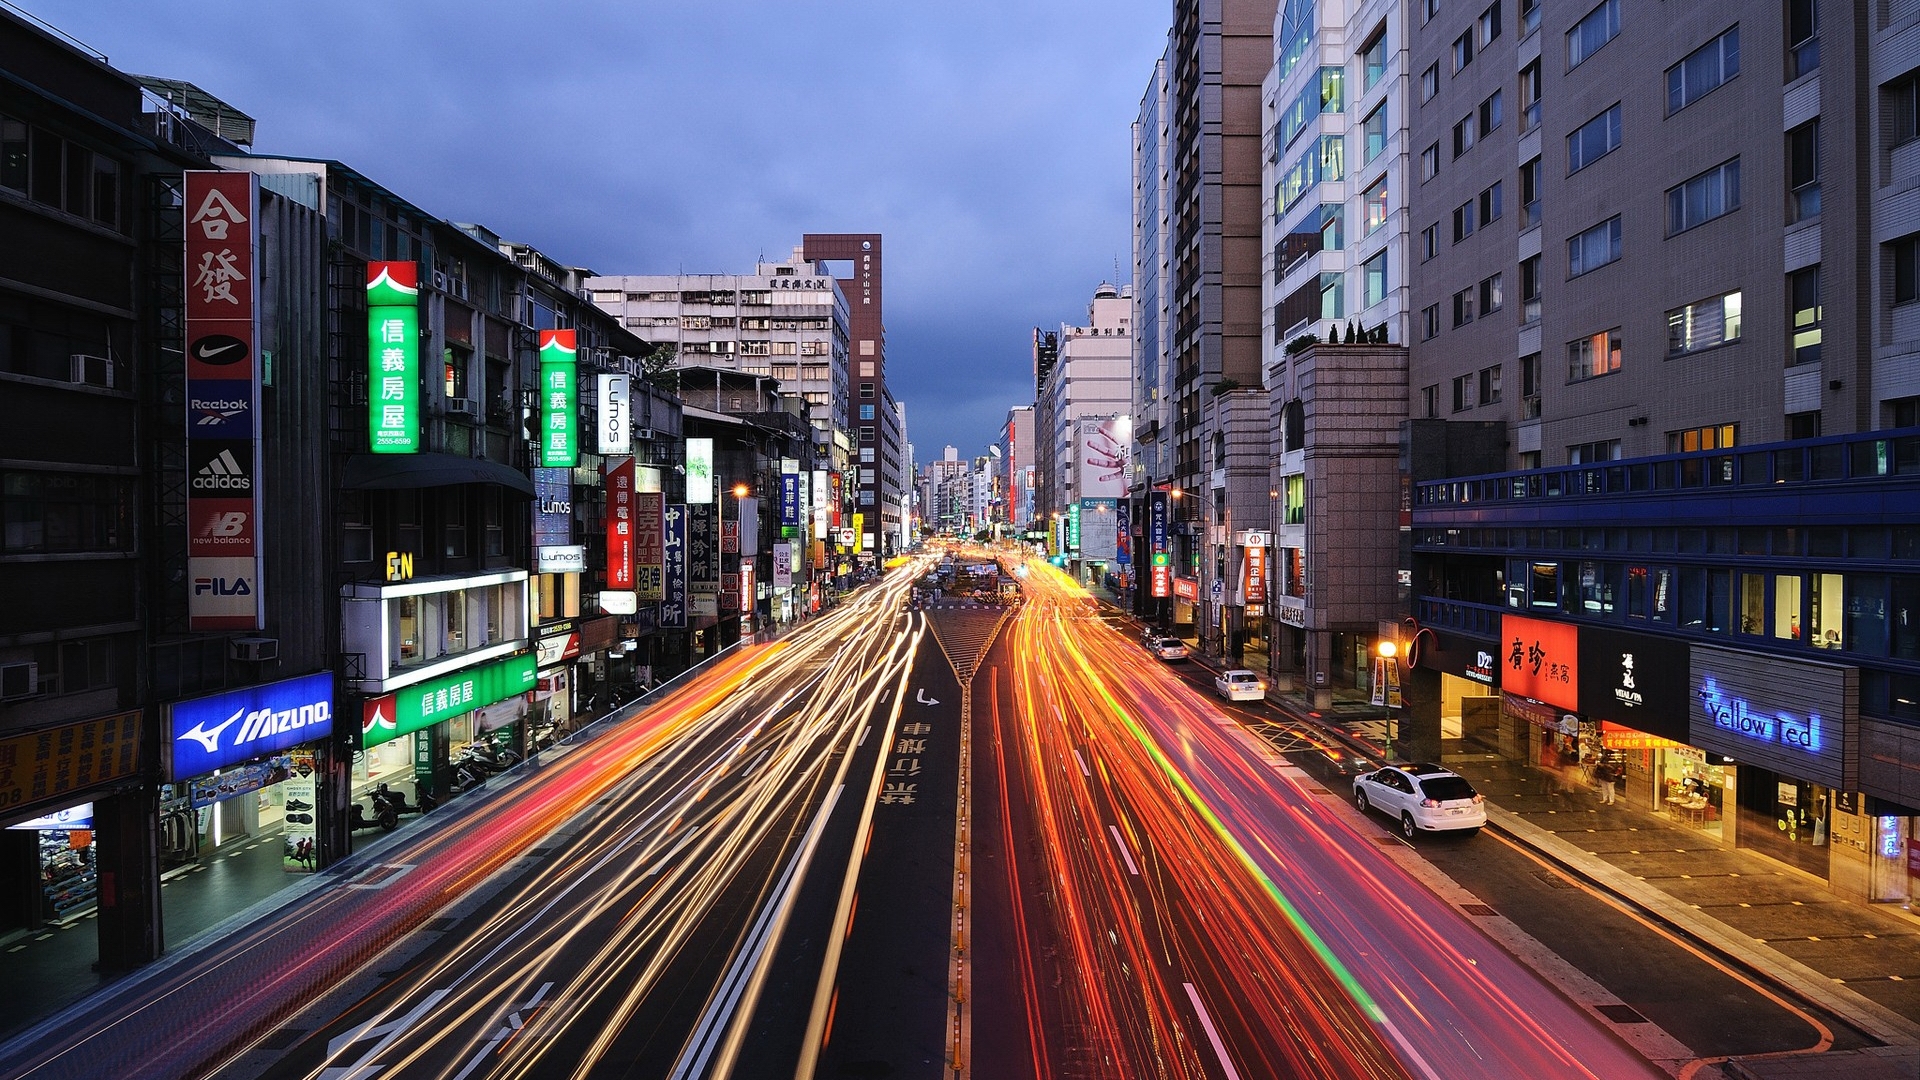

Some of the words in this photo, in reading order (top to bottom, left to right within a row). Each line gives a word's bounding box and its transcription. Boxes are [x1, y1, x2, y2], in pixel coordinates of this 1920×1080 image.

[190, 188, 248, 305] 合發
[381, 319, 405, 428] 信義房屋
[191, 399, 248, 410] Reebok
[549, 371, 567, 450] 信義房屋
[192, 474, 250, 489] adidas
[201, 511, 247, 537] NB
[616, 476, 629, 535] 遠傳電信
[638, 495, 660, 547] 壓克力
[193, 536, 212, 544] new
[213, 536, 251, 544] balance
[665, 507, 681, 547] 中山
[195, 578, 250, 596] FILA
[638, 565, 661, 592] 招牌
[1508, 637, 1546, 676] 廣珍
[1550, 662, 1570, 684] 燕窩
[421, 680, 474, 717] 信義房屋
[1709, 701, 1766, 735] Yellow
[1773, 717, 1811, 747] Ted
[880, 722, 931, 805] 禁行機車
